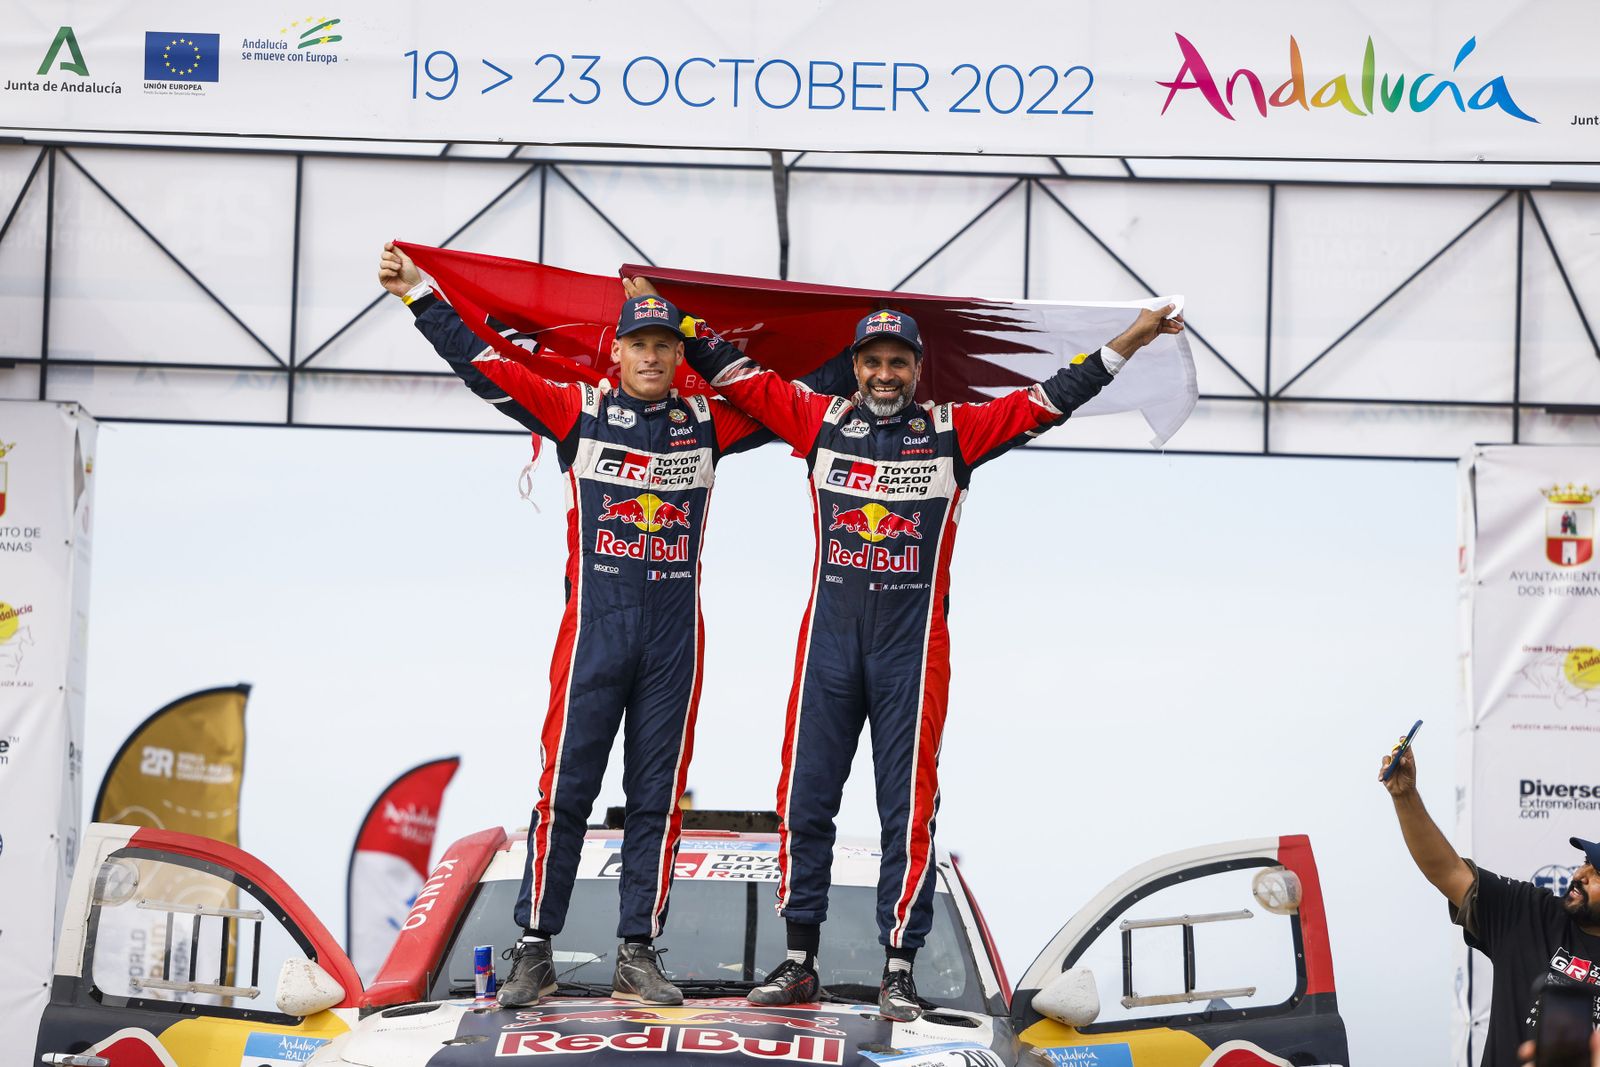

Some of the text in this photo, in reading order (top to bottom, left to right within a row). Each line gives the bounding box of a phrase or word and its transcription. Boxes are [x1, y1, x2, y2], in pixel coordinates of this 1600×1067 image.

[242, 38, 288, 50] Andalucía
[242, 52, 338, 64] se mueve con Europa
[404, 50, 459, 100] 19
[532, 54, 601, 105] 23
[622, 56, 930, 112] OCTOBER
[949, 63, 1095, 115] 2022
[1155, 32, 1542, 124] Andalucía
[4, 80, 122, 94] Junta de Andalucía
[143, 82, 202, 91] UNIÓN EUROPEA
[1570, 115, 1600, 126] Junt
[635, 309, 669, 320] Red Bull
[866, 322, 901, 334] Red Bull
[669, 425, 694, 437] Qatar
[903, 435, 931, 446] Qatar
[656, 455, 701, 467] TOYOTA
[596, 458, 647, 481] GR
[653, 466, 697, 477] GAZOO
[882, 464, 938, 475] TOYOTA
[651, 476, 694, 486] Racing
[827, 469, 873, 491] GR
[878, 475, 931, 485] GAZOO
[875, 485, 928, 496] Racing
[0, 527, 41, 538] TO DE
[595, 529, 690, 562] Red Bull
[828, 538, 920, 573] Red Bull
[1509, 571, 1600, 582] AYUNTAMIENT
[1518, 585, 1545, 597] DOS
[717, 854, 779, 863] TOY
[711, 862, 780, 871] GAZ
[706, 870, 781, 880] Raci
[1550, 955, 1588, 981] GR
[495, 1026, 846, 1066] Red Bull
